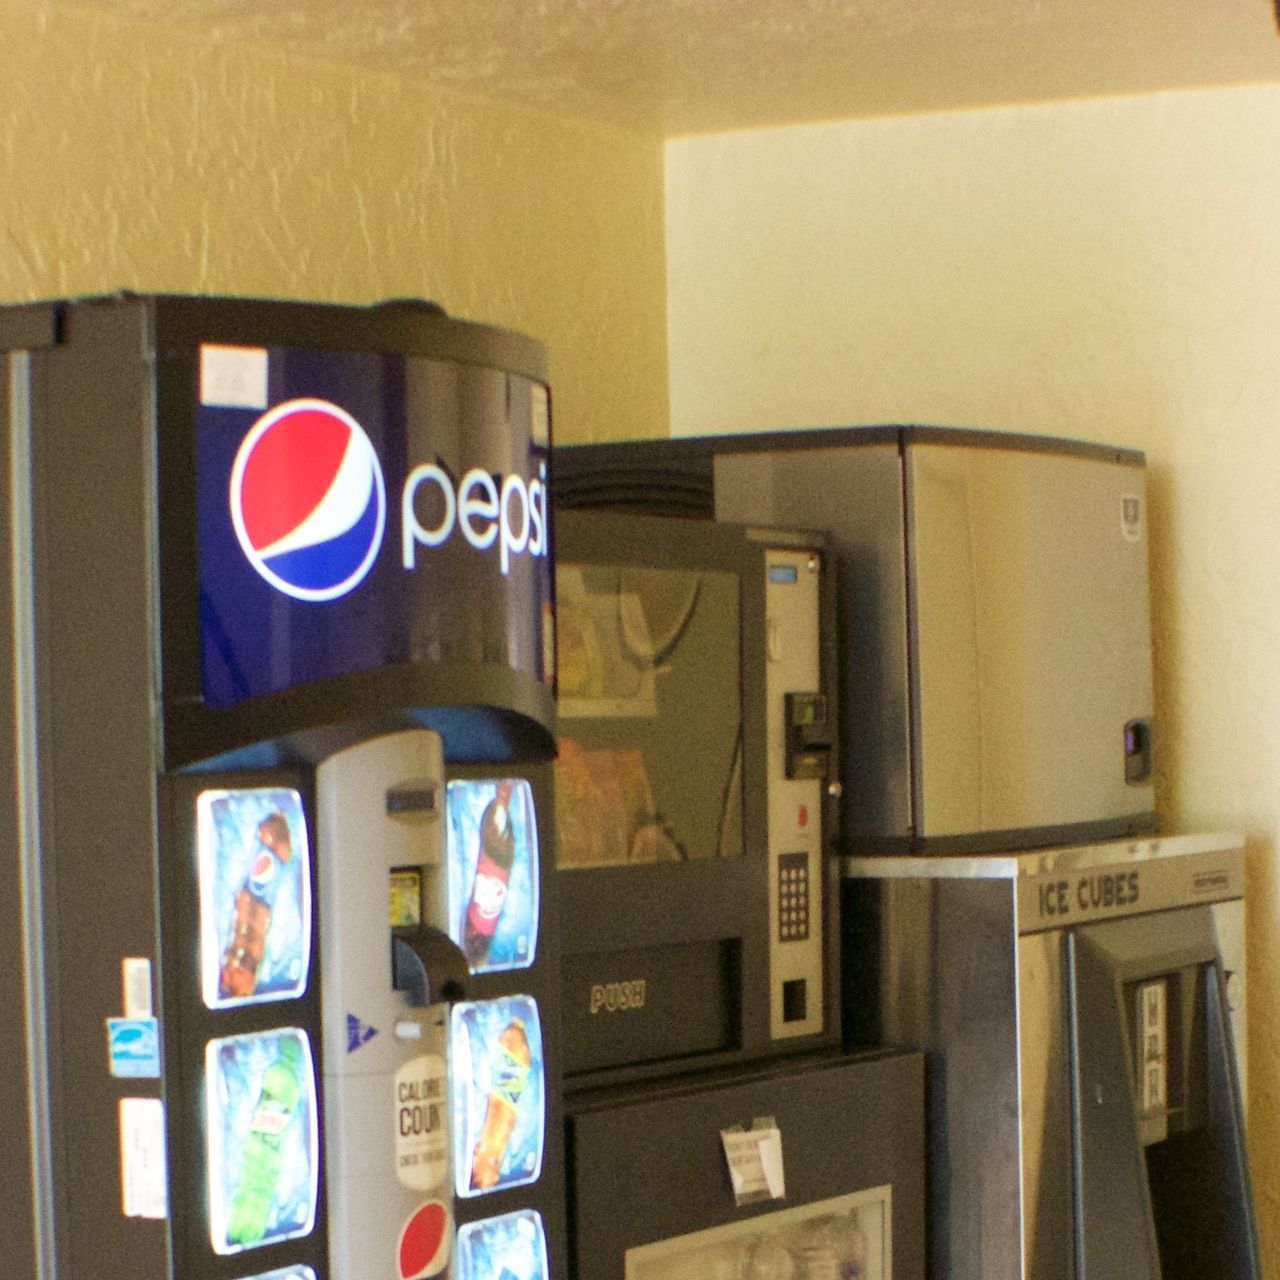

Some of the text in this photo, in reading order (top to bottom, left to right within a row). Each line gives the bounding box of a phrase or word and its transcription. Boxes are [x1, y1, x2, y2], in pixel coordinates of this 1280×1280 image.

[402, 461, 548, 575] pepsi
[1038, 871, 1139, 917] ICE CUBES
[590, 979, 646, 1014] PUSH
